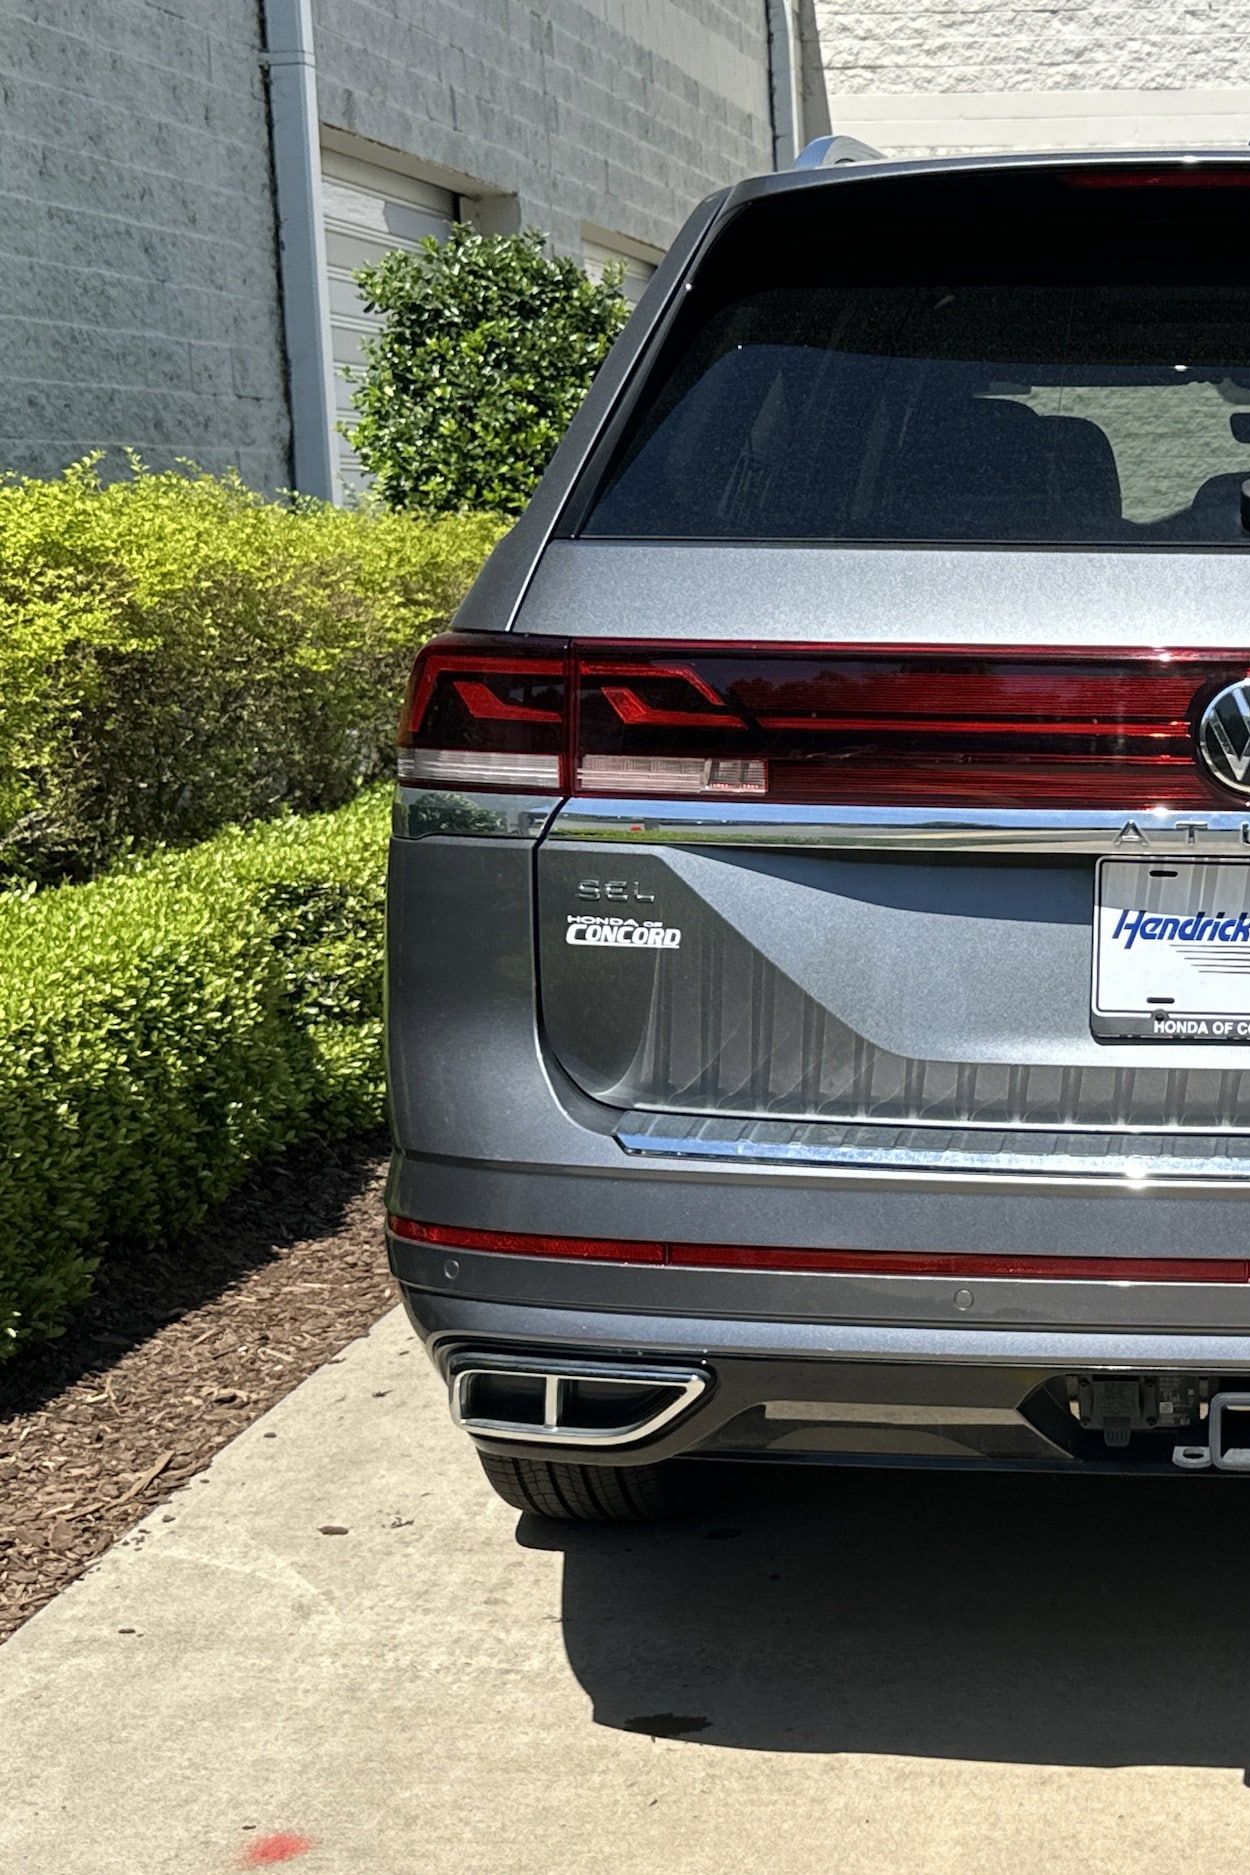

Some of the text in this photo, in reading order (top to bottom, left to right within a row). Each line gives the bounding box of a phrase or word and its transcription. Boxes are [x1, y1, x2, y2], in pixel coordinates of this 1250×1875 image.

[576, 879, 655, 902] SEL
[567, 915, 638, 927] HONDA
[566, 923, 681, 949] CONCORD
[1153, 1020, 1208, 1034] HONDA
[1212, 1021, 1234, 1035] OF
